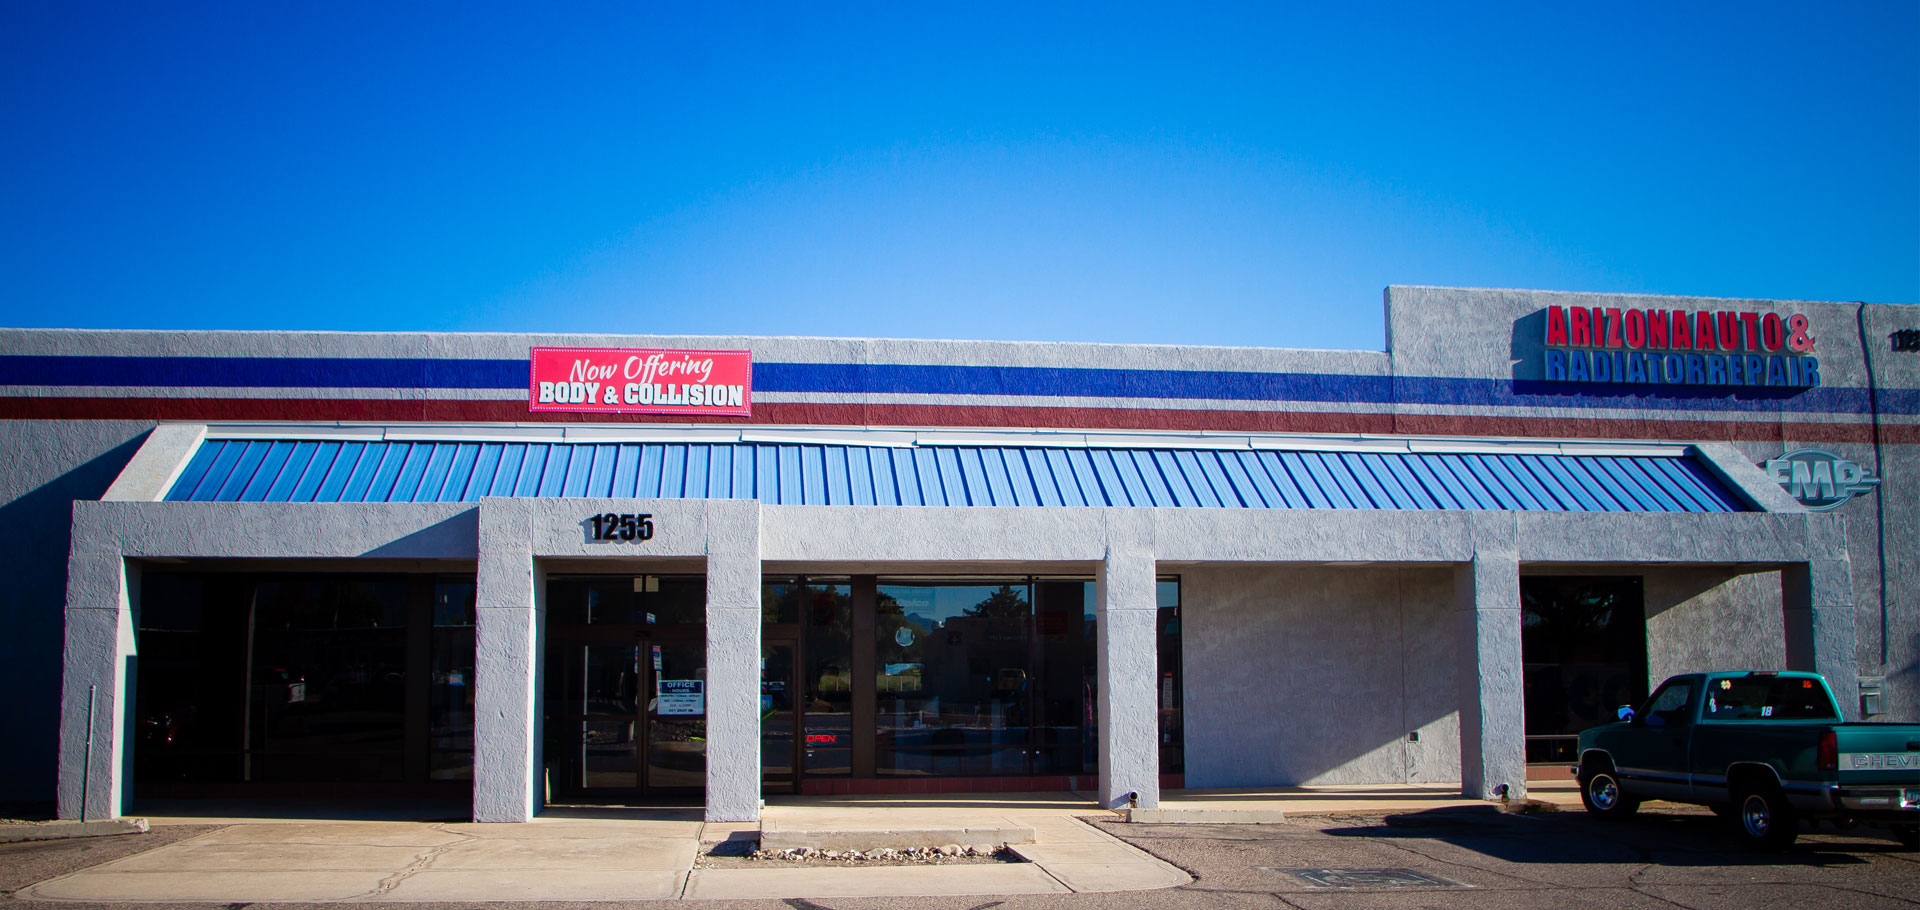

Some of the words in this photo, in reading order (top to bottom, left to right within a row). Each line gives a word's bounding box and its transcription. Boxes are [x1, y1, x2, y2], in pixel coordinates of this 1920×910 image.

[1786, 313, 1816, 353] &
[570, 358, 617, 382] Now
[624, 354, 714, 384] Offering
[538, 381, 601, 404] BODY
[603, 385, 620, 405] &
[624, 382, 744, 407] COLLISION
[590, 512, 654, 541] 1255
[1761, 706, 1773, 717] 18
[806, 734, 836, 743] OPEN
